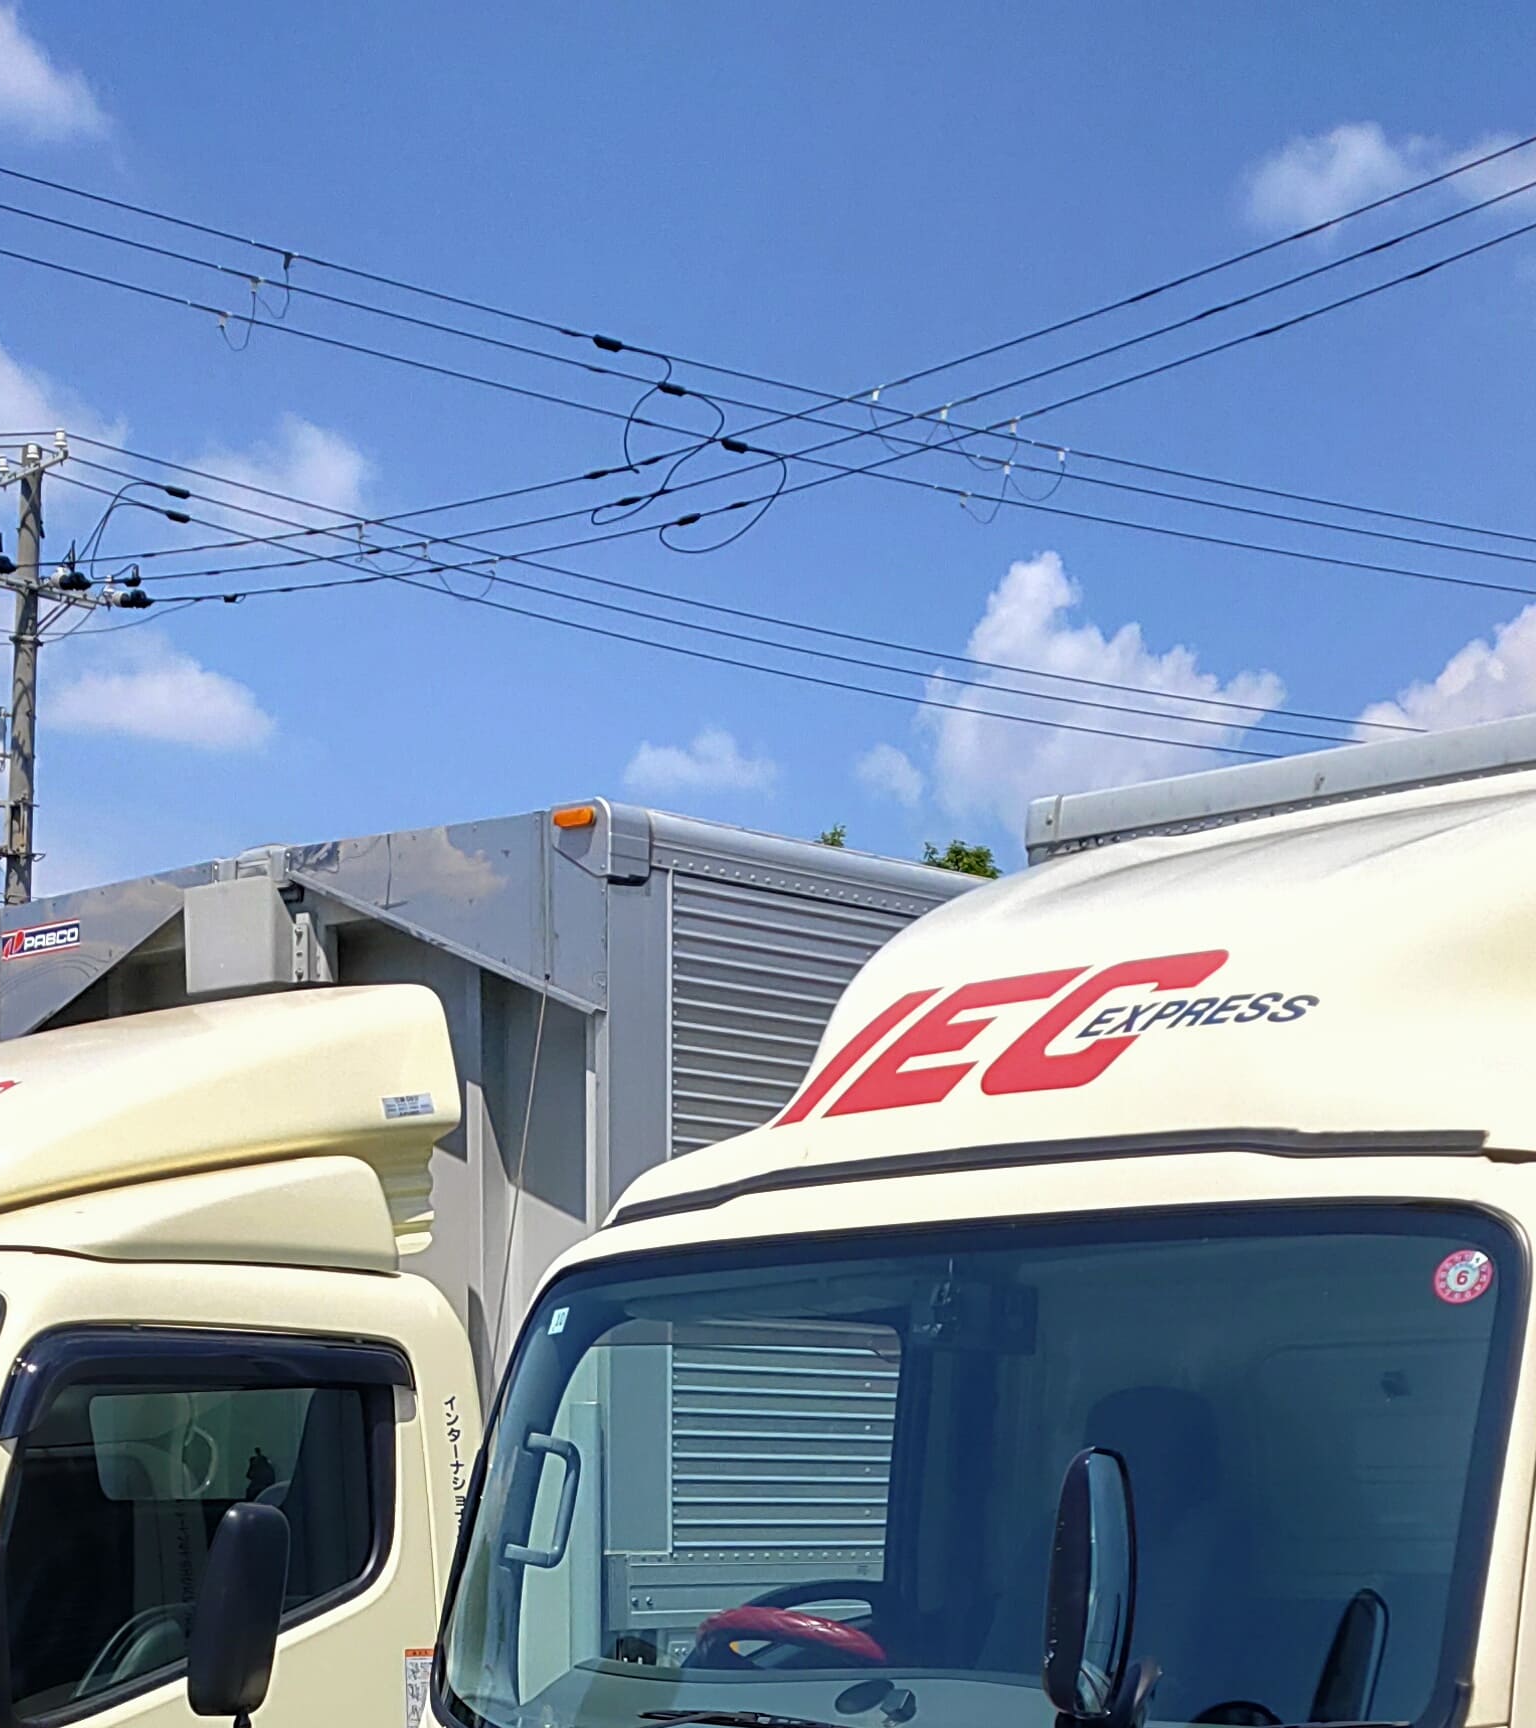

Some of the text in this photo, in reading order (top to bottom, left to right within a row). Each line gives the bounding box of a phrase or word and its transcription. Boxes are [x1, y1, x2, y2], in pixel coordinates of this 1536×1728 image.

[23, 927, 79, 951] PABCO
[770, 949, 1321, 1129] IEC EXPRESS
[1456, 1269, 1470, 1286] 6
